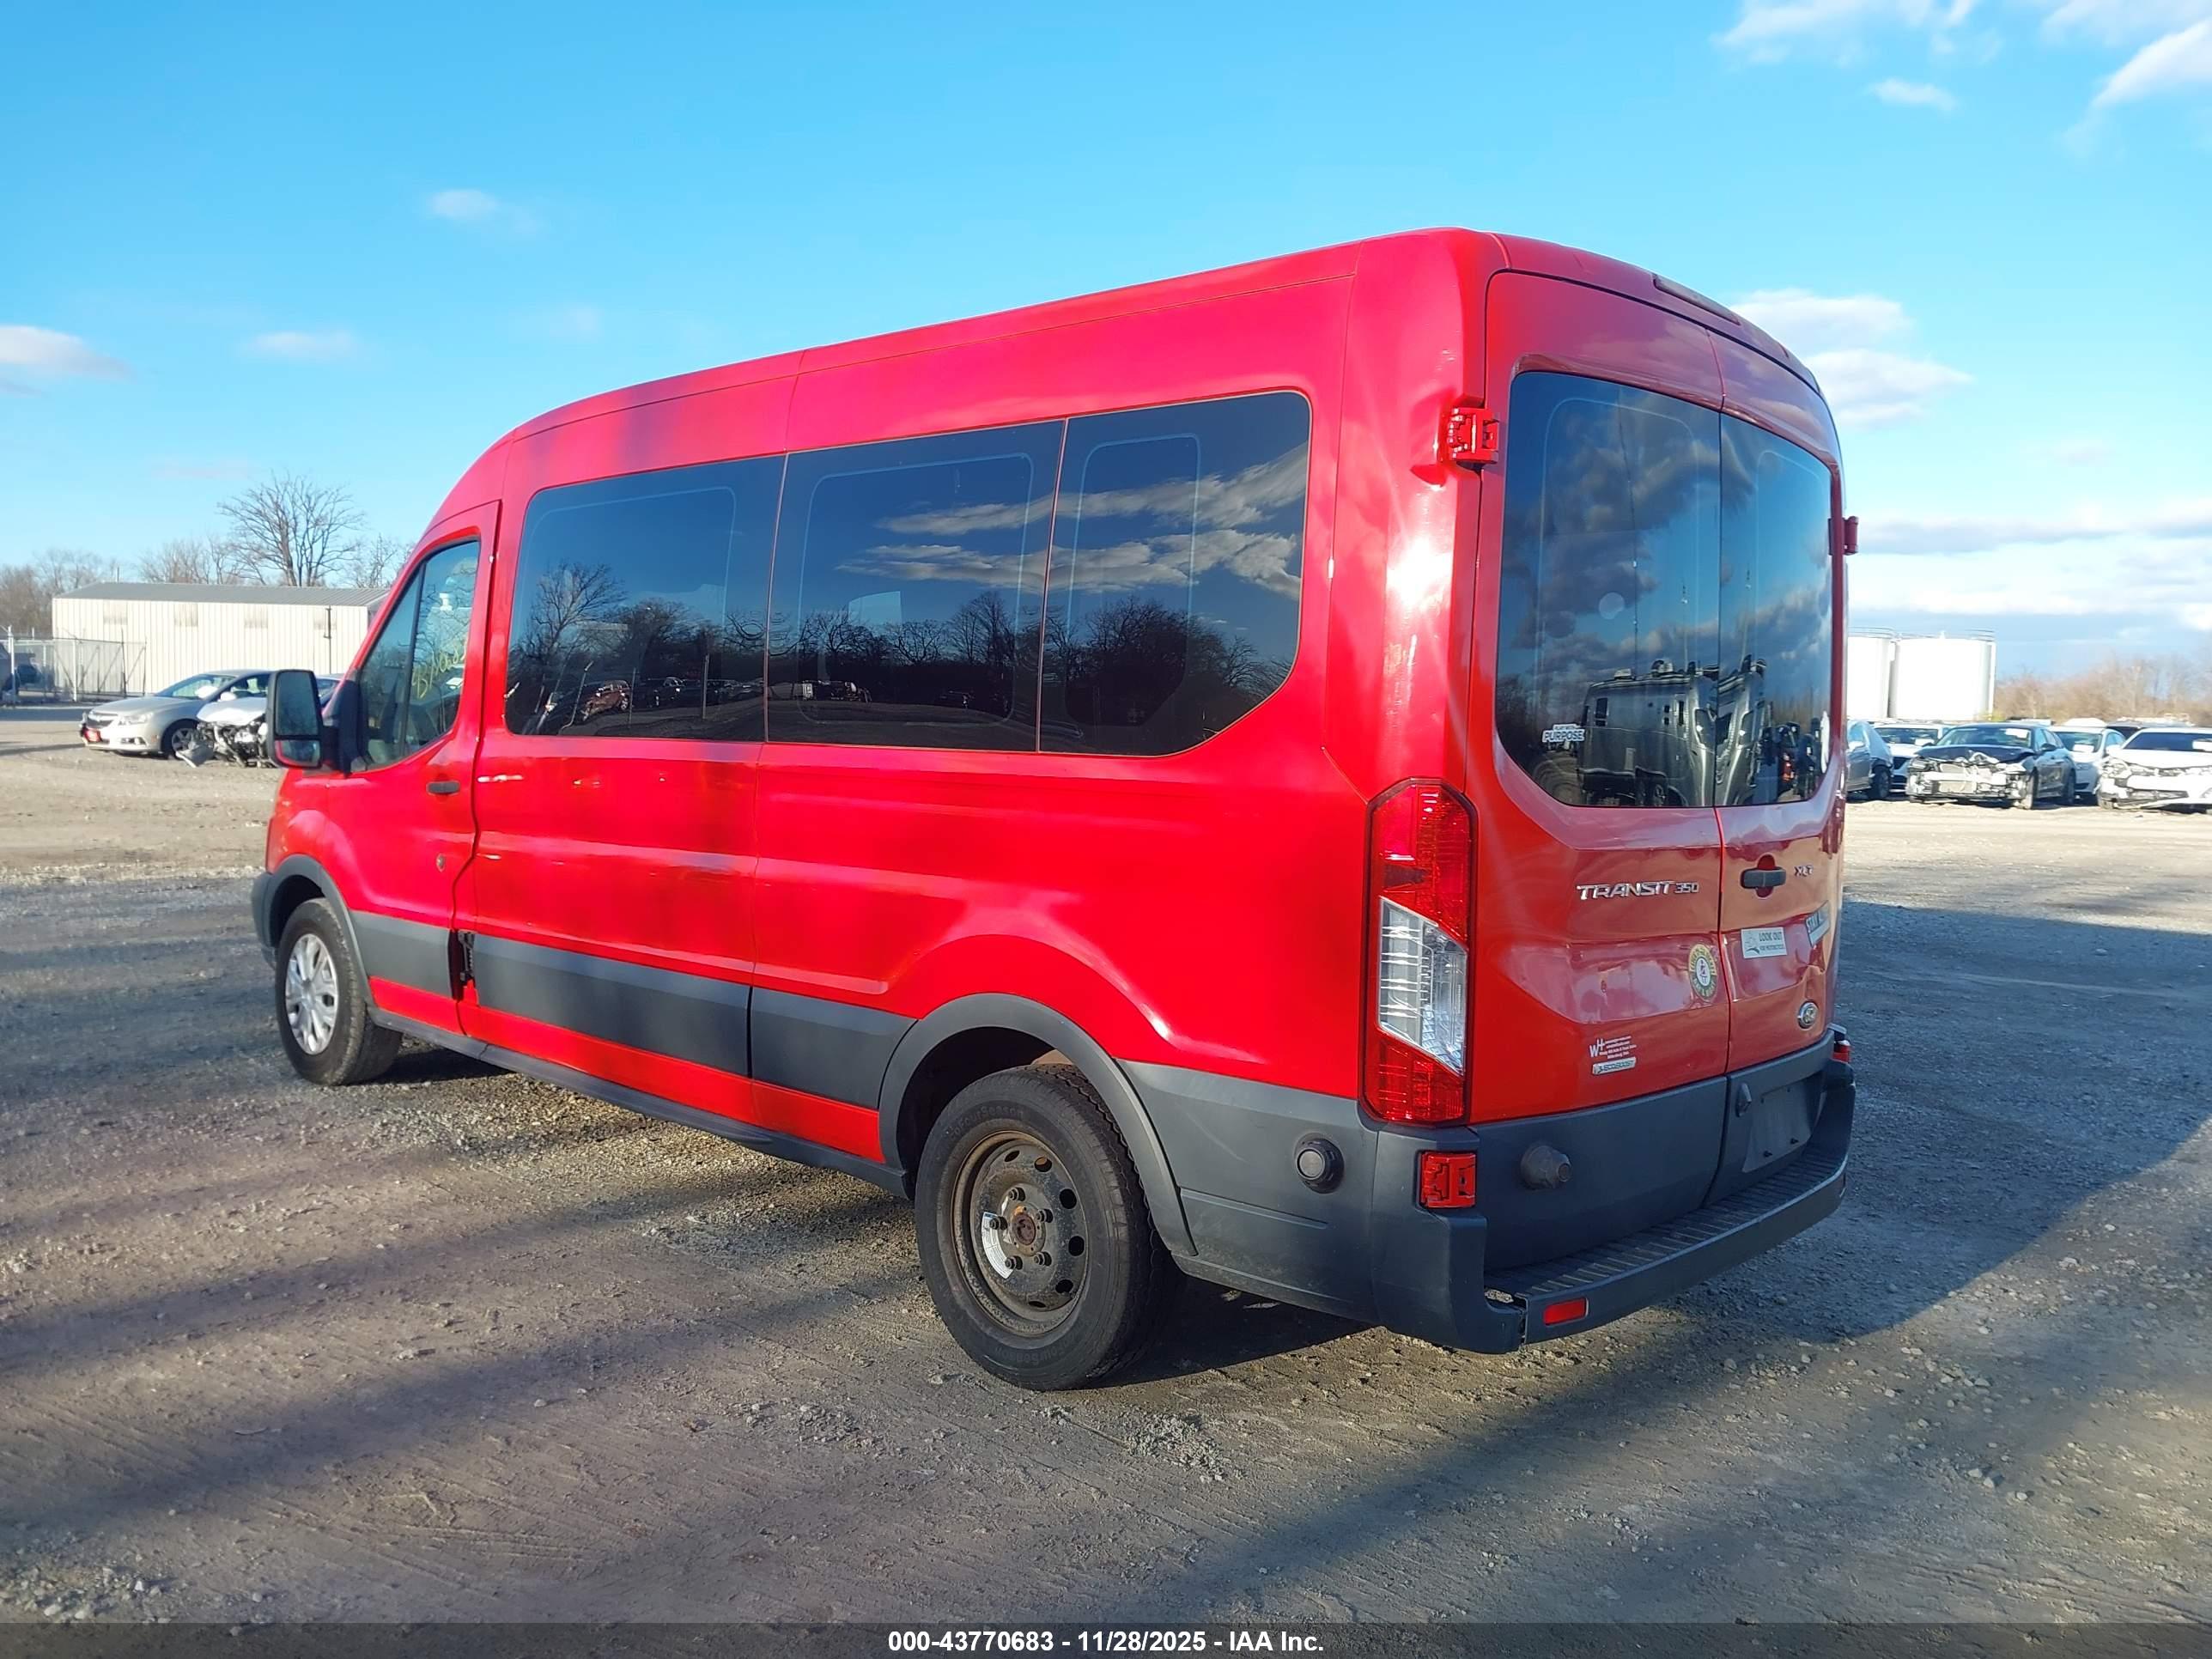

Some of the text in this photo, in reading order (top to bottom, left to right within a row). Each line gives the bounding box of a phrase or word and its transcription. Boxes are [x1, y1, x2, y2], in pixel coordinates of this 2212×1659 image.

[1544, 730, 1583, 741] PURPOSE
[1577, 880, 1699, 901] TRANSIT 350
[1759, 932, 1772, 941] LOOK
